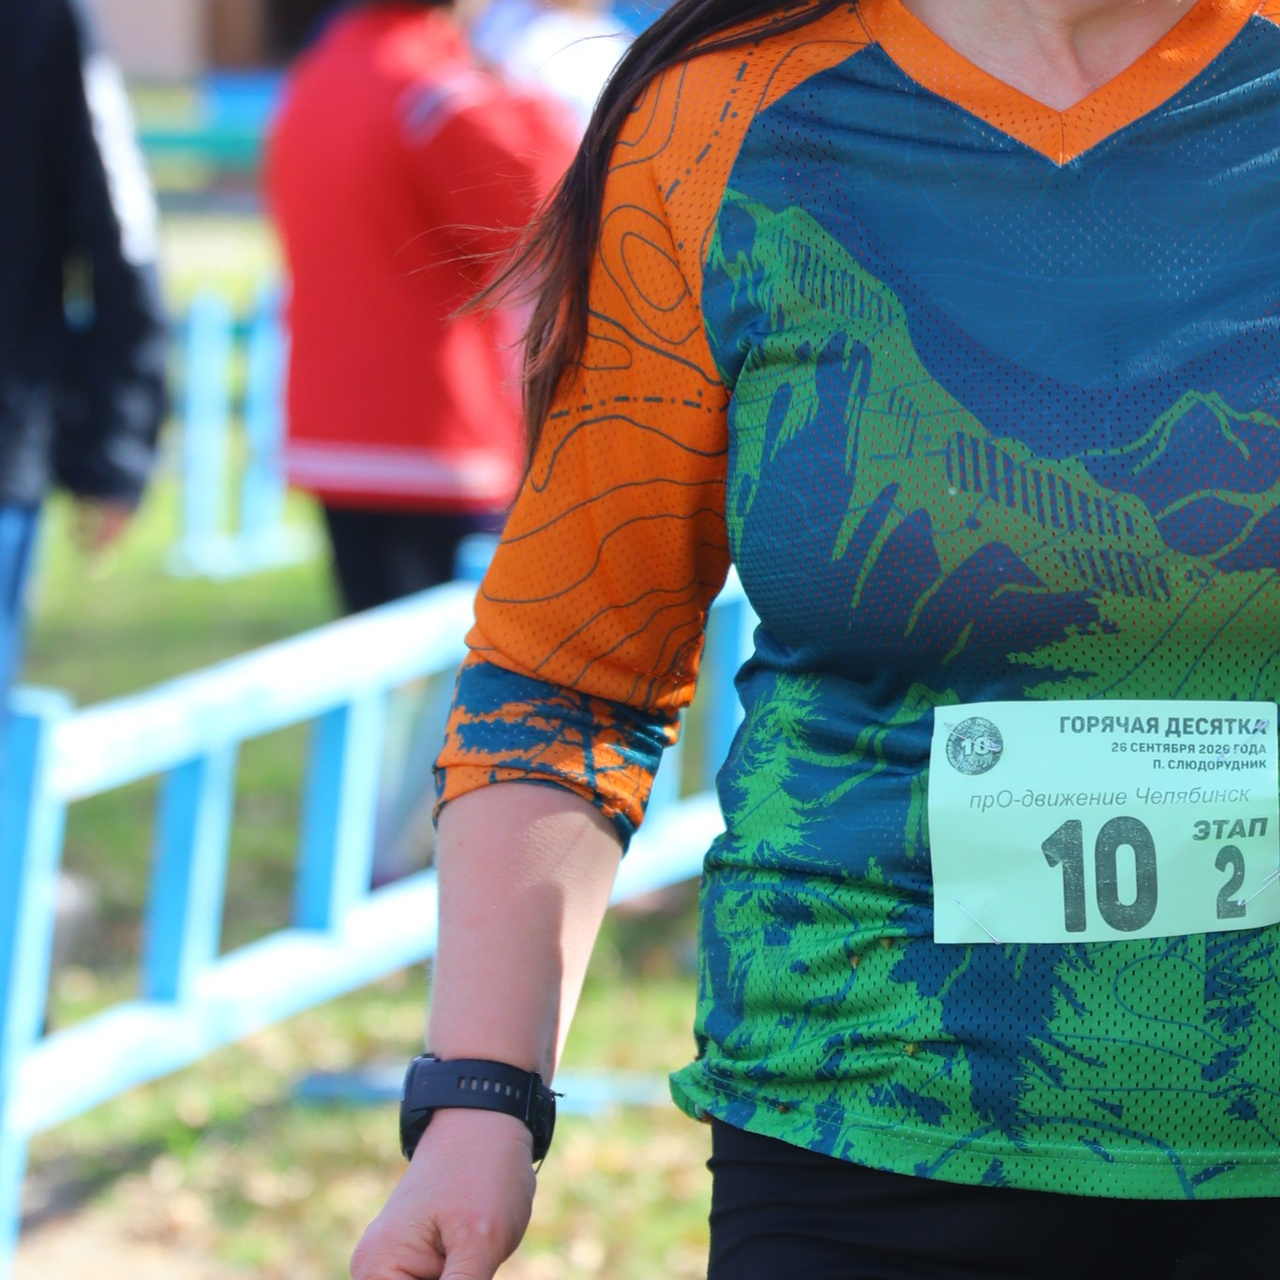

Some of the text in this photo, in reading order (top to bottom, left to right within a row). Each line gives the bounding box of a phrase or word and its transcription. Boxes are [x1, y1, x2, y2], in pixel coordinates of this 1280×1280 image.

[1059, 715, 1267, 738] ГОРЯЧАЯ ДЕСЯТКА
[1111, 742, 1127, 753] 26
[1130, 742, 1196, 754] СЕНТЯБРЯ
[1233, 744, 1267, 756] ГОДА
[1153, 759, 1267, 772] П. СЛЮДОРУДНИК
[968, 786, 1250, 813] прО-движение Челябинск
[1192, 817, 1268, 841] ЭТАП
[1040, 815, 1159, 934] 10
[1214, 844, 1247, 920] 2
